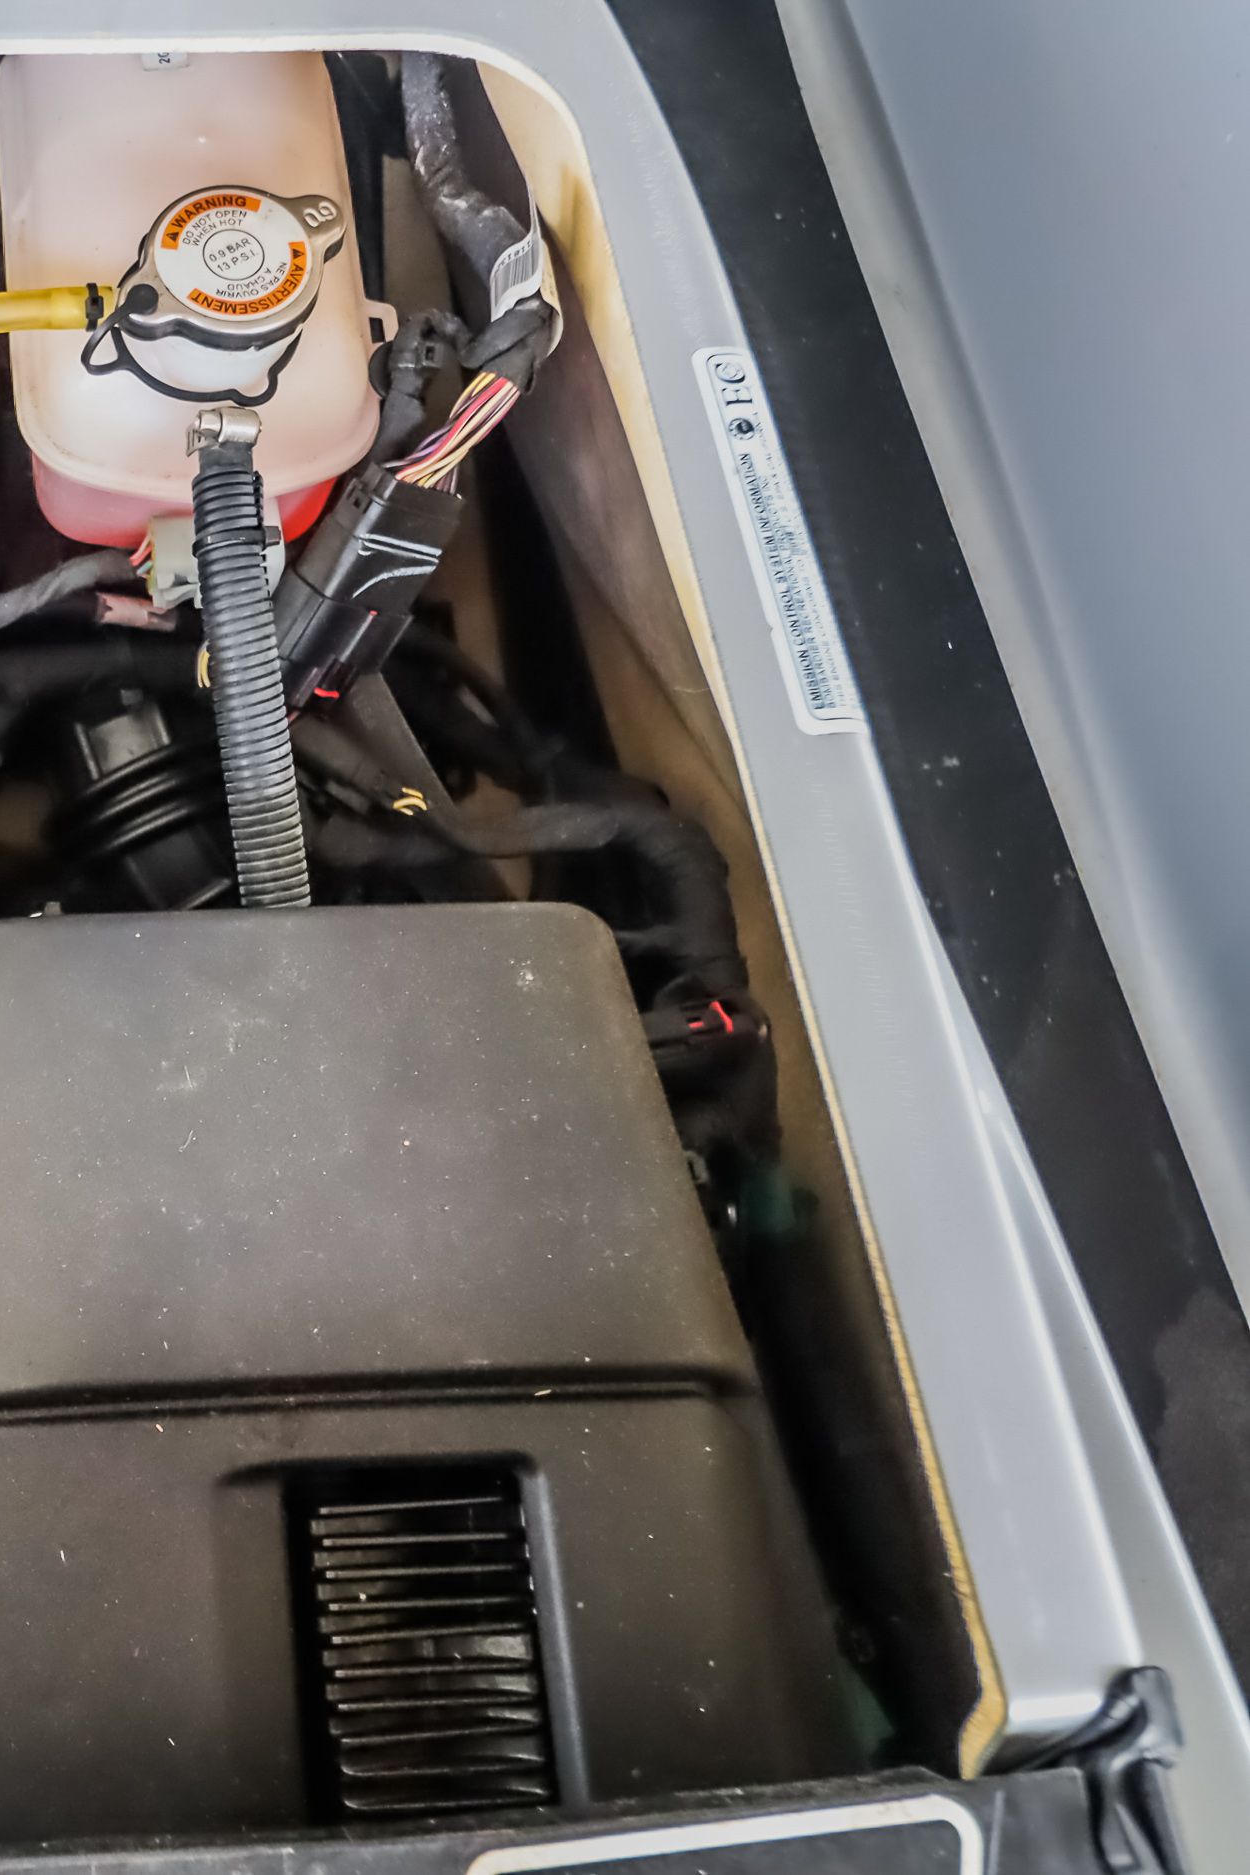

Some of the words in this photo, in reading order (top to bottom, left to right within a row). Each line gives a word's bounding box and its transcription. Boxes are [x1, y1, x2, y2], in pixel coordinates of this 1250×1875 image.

[171, 195, 247, 229] WARNING
[182, 230, 194, 245] DO
[192, 213, 211, 231] NOT
[215, 209, 248, 219] OPEN
[191, 222, 217, 246] WHEN
[219, 217, 243, 227] HOT
[226, 238, 252, 254] BAR
[217, 261, 231, 272] 13
[227, 275, 266, 291] CHAUD
[260, 275, 280, 291] PAS
[275, 261, 287, 275] NE
[191, 262, 304, 315] AVERTISSEMENT
[215, 288, 260, 299] OUVRIR
[737, 452, 771, 533] INFORMATION
[763, 534, 788, 584] SYSTEM
[781, 553, 814, 634] RECREATIONAL
[779, 590, 806, 646] CONTROL
[797, 648, 825, 710] EMISSION
[806, 637, 836, 708] BOMBARDIER
